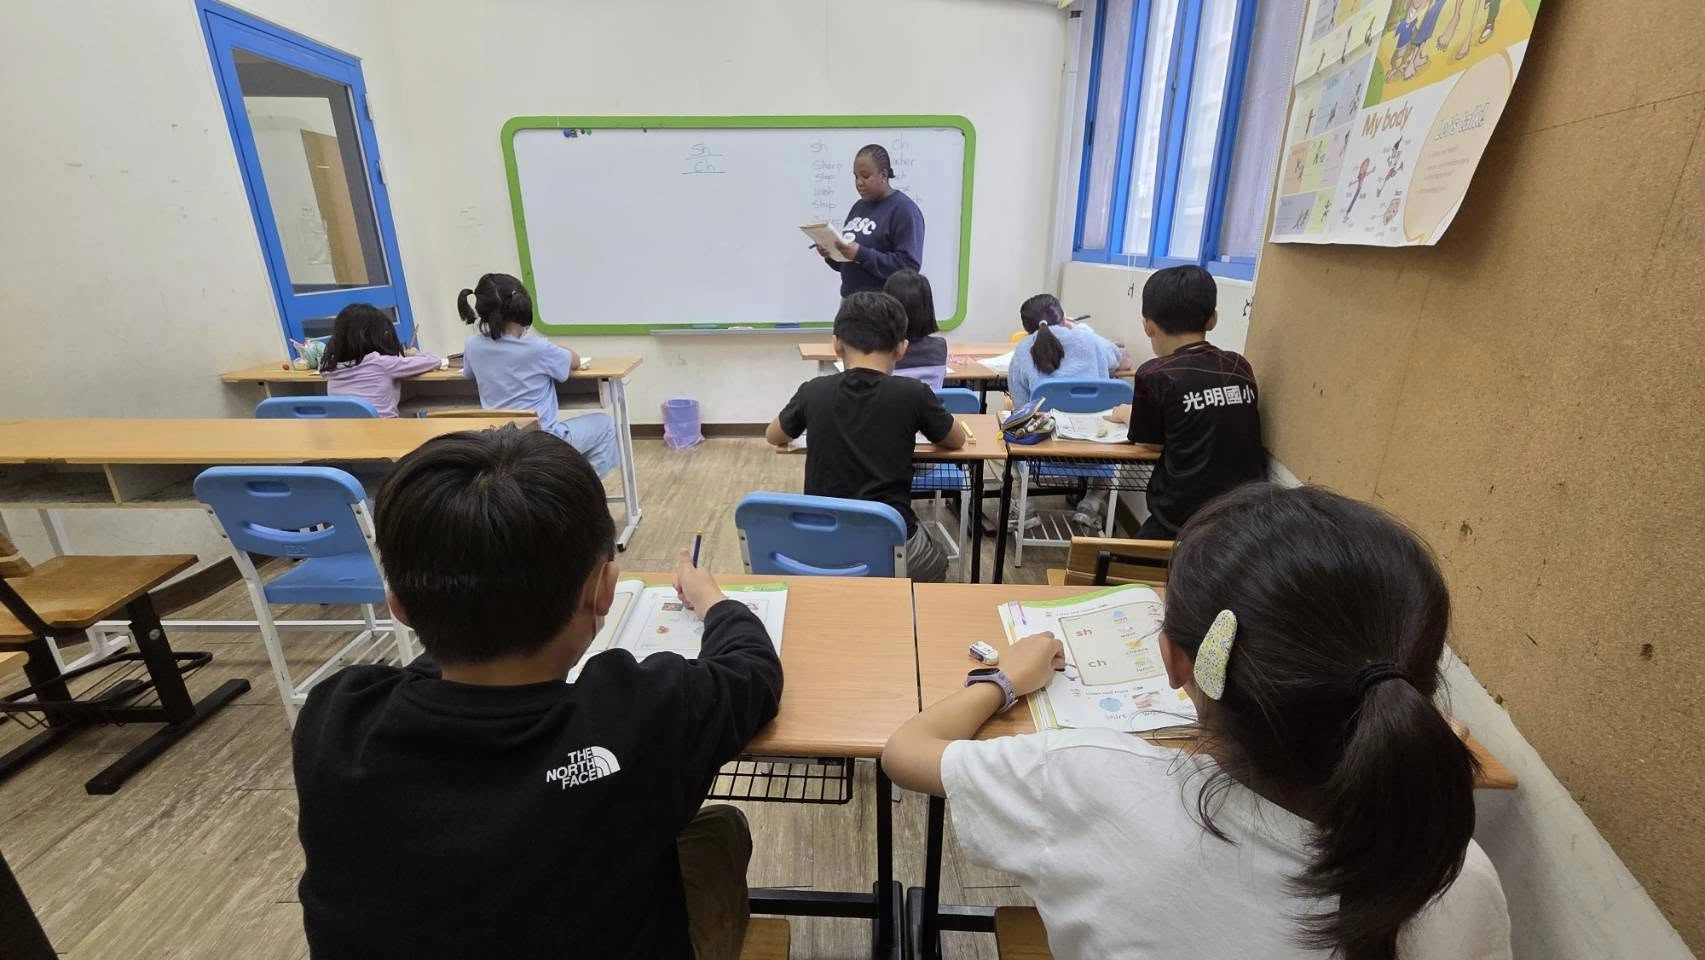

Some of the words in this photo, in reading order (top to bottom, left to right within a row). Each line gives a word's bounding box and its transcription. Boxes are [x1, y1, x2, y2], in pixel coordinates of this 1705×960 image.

[1361, 112, 1383, 139] My
[1382, 100, 1413, 131] body
[1182, 384, 1255, 413] 光明國小
[1075, 628, 1093, 637] sh
[1088, 658, 1107, 668] ch
[567, 747, 594, 764] THE
[546, 757, 597, 783] NORTH
[562, 768, 598, 790] FACE
